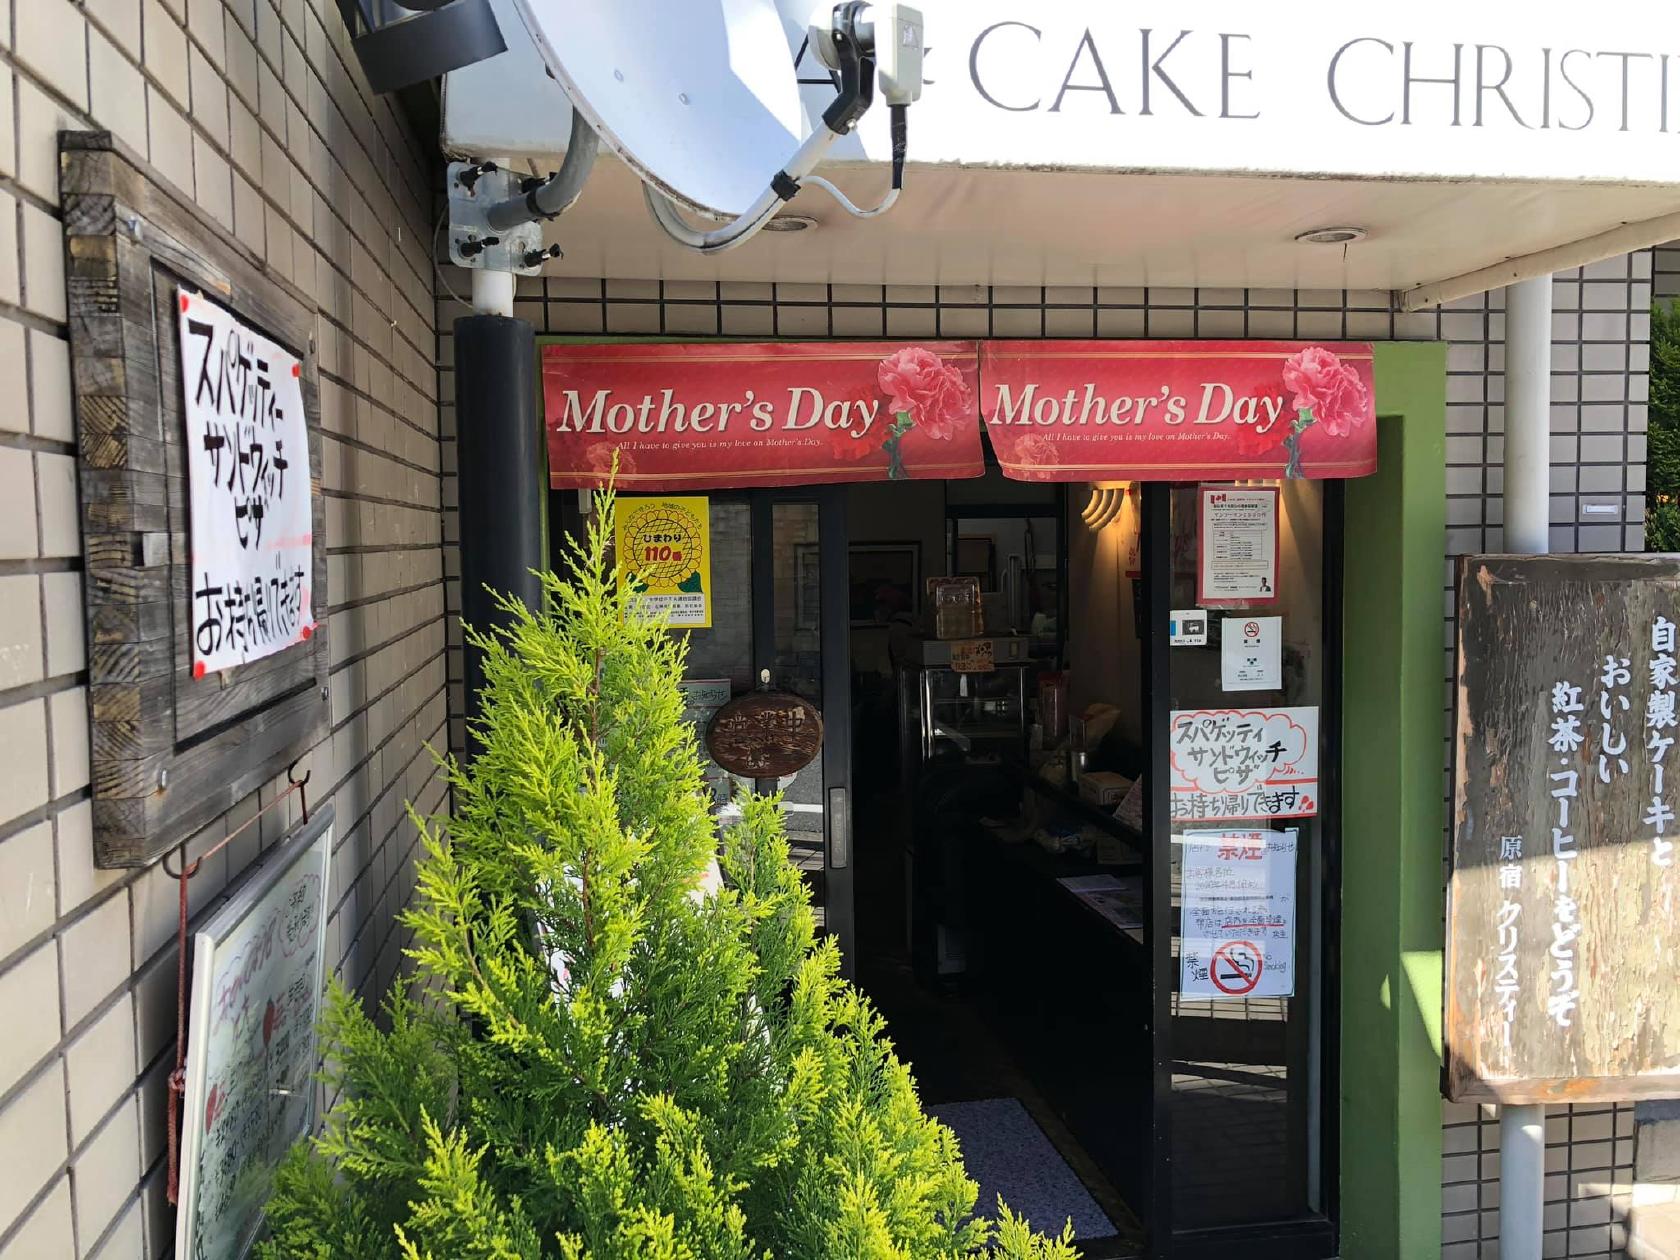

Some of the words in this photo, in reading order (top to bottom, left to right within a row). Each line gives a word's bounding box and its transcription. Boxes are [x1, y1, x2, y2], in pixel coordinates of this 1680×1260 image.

[969, 20, 1261, 119] CAKE
[1328, 36, 1680, 133] CHRISTI
[557, 387, 775, 433] Mother's
[782, 386, 879, 438] Day
[989, 382, 1186, 426] Mother's
[1194, 382, 1283, 433] Day
[203, 420, 288, 500] サンドウィッチ
[234, 495, 270, 551] ピザ
[643, 533, 682, 544] ひまわり
[1176, 716, 1265, 745] スパゲッティ
[1600, 655, 1631, 785] おいしい
[1643, 616, 1678, 867] 自家製ケーキと
[1187, 741, 1287, 768] サンドウィッチ
[1214, 765, 1260, 785] ピザ
[1171, 785, 1300, 819] お持ち帰りできます
[1499, 834, 1523, 889] 原宿
[1493, 899, 1522, 1047] クリスティー
